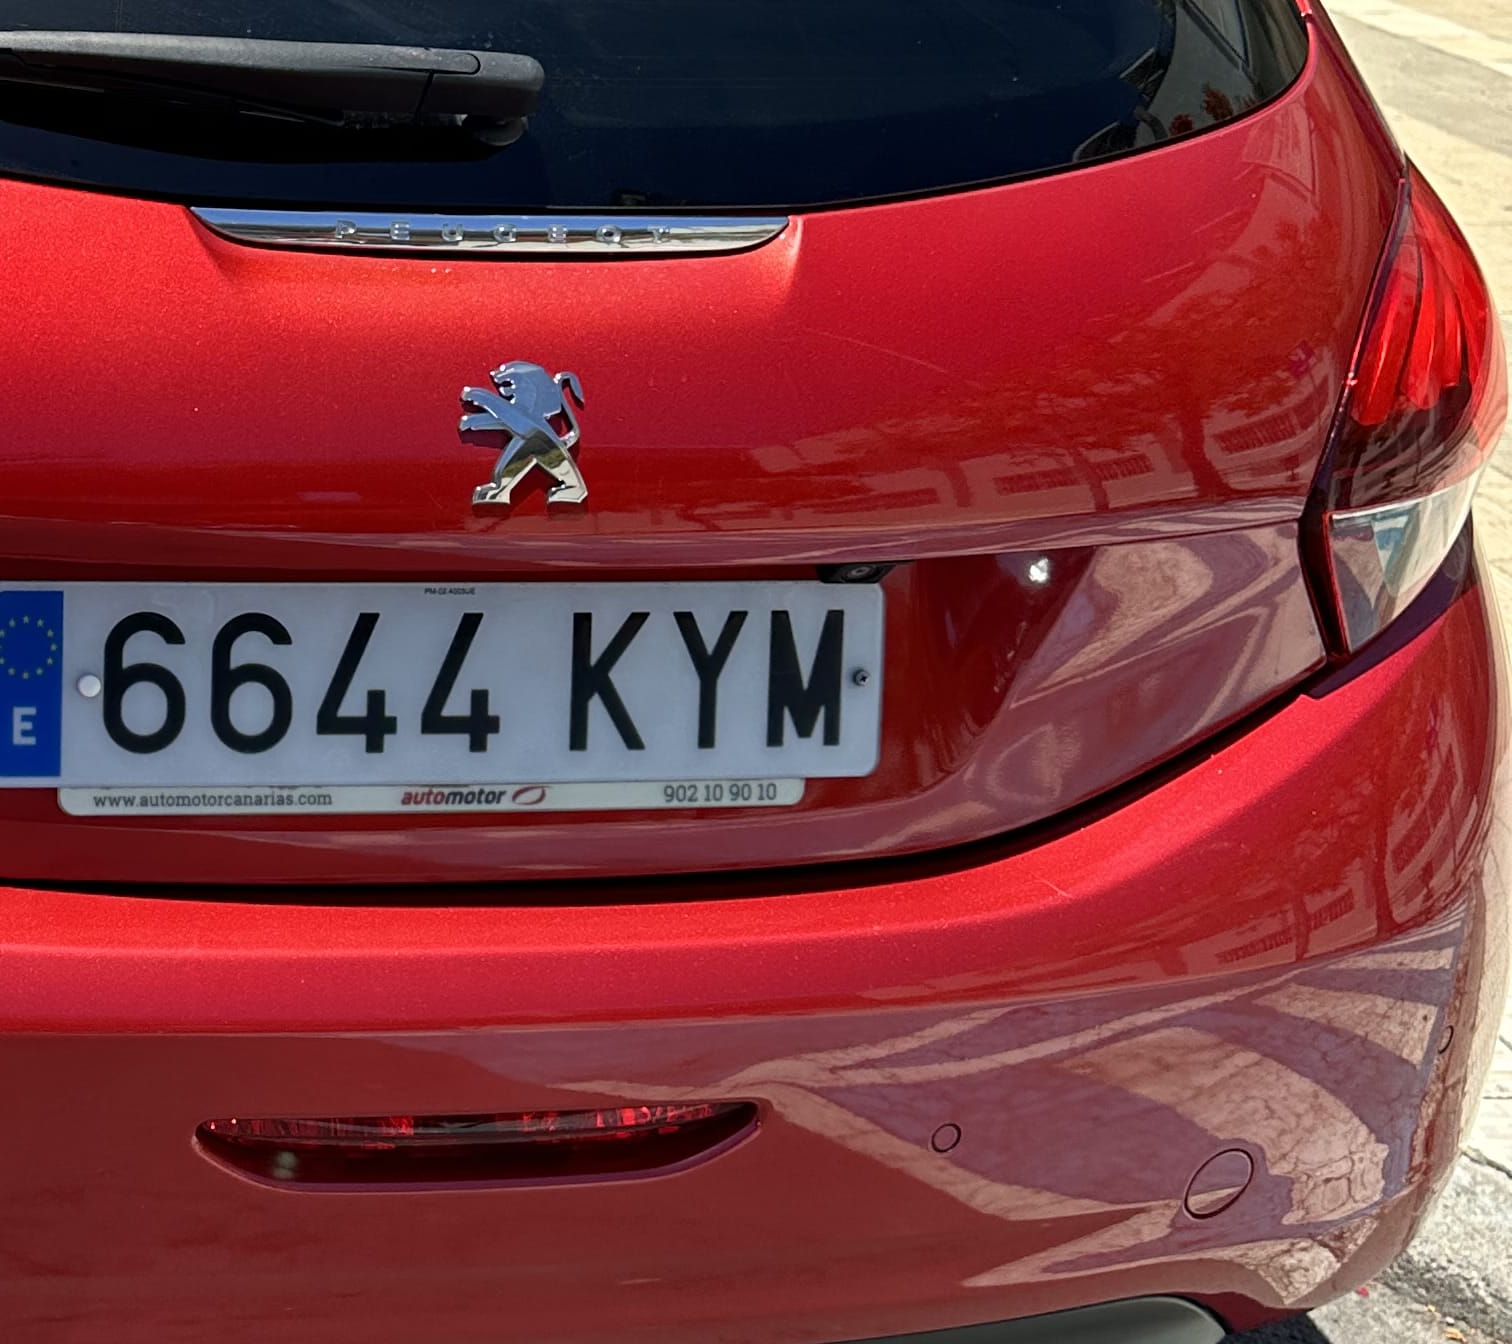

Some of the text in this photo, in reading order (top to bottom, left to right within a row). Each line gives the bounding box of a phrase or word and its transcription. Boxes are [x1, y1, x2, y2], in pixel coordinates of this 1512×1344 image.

[335, 219, 671, 245] PEUGEOT
[102, 609, 845, 754] 6644 KYM
[11, 706, 38, 746] E
[92, 790, 333, 808] www.automotorcanarias.com
[400, 787, 507, 806] automotor
[663, 782, 777, 803] 902 10 90 10
